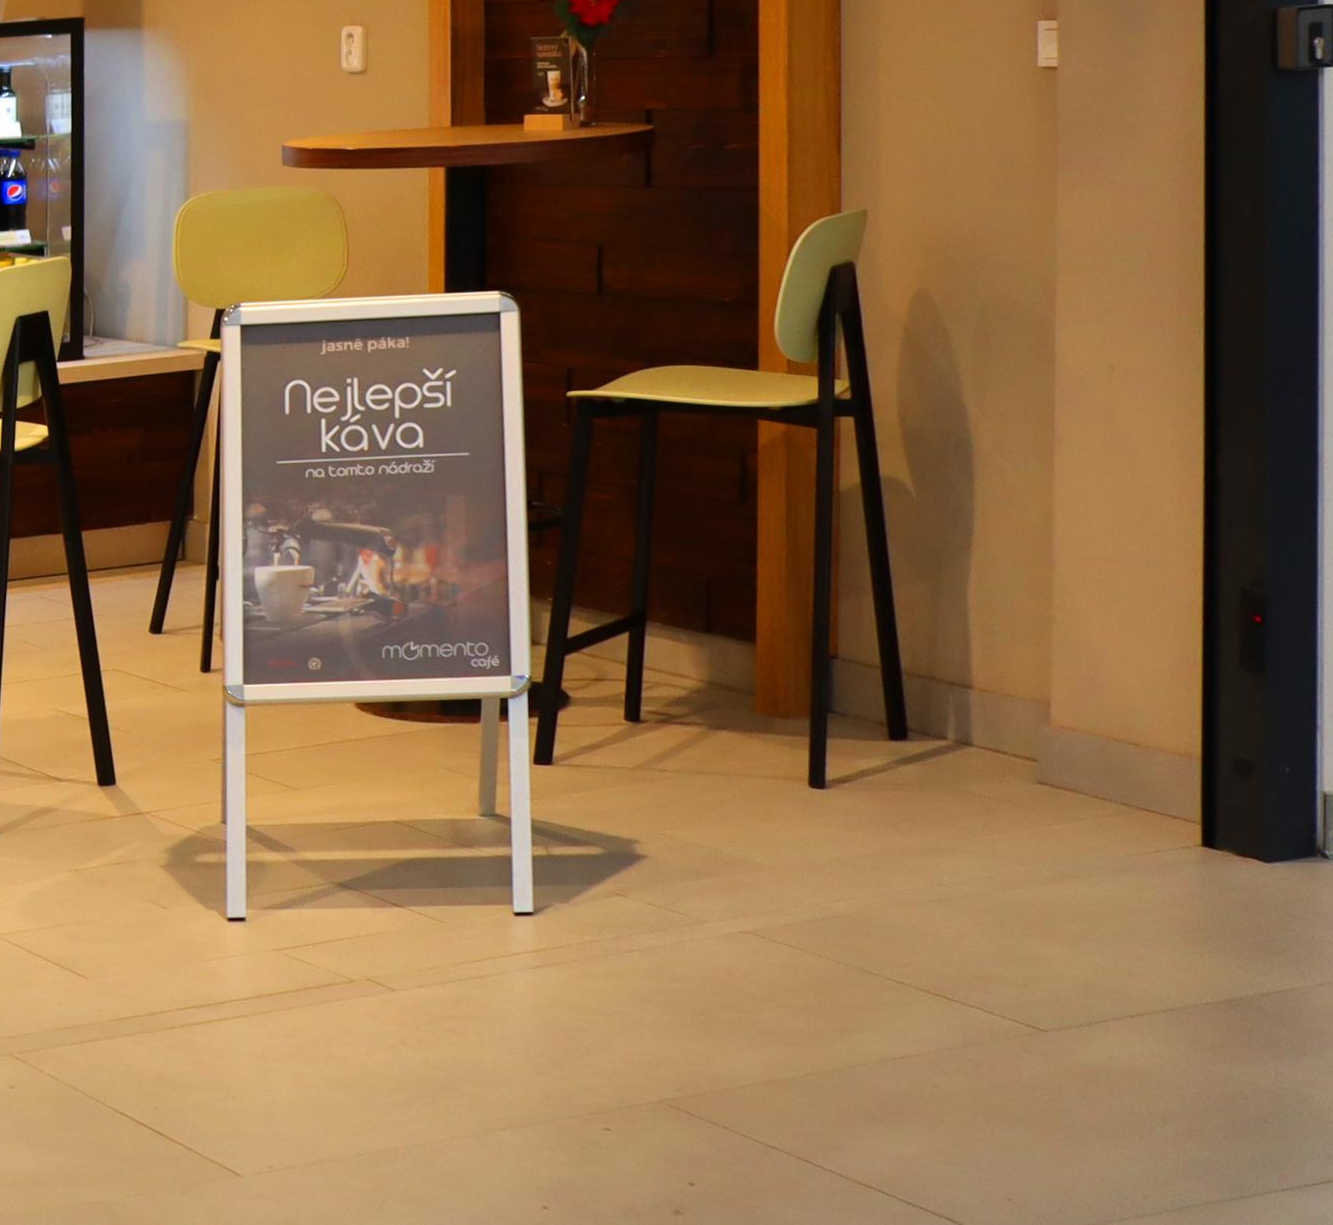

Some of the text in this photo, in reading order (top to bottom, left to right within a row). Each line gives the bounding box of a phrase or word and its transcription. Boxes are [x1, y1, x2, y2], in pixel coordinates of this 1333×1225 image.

[367, 336, 410, 353] páka!
[284, 367, 457, 422] Nejlepší
[320, 414, 425, 454] káva
[305, 459, 436, 479] na tomto nádraží
[381, 641, 490, 661] momento
[470, 655, 501, 670] café
